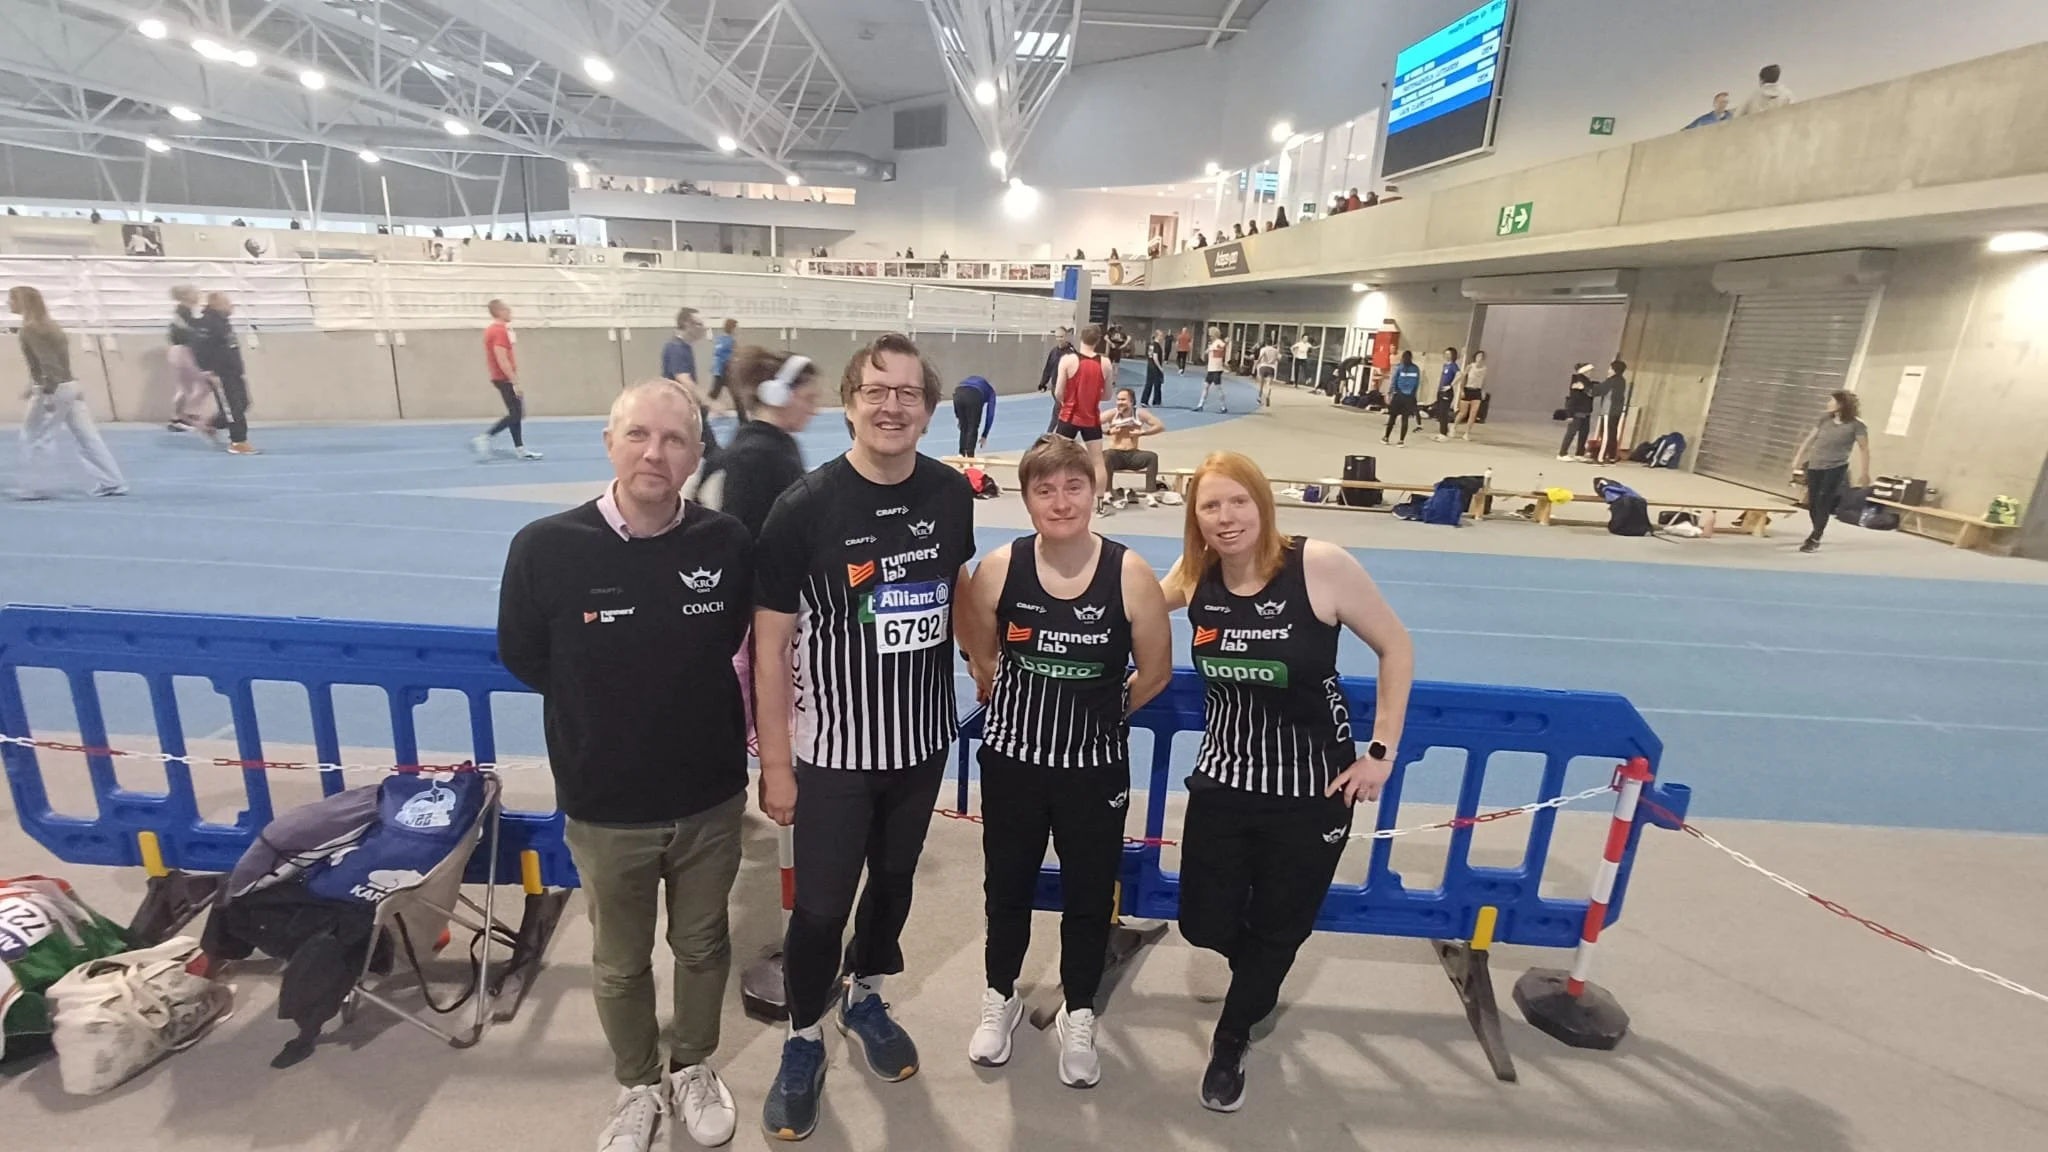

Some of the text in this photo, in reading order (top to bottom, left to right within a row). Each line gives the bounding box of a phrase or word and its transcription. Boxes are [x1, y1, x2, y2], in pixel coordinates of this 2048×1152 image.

[875, 507, 903, 517] CRAFT
[845, 536, 871, 546] CRAFT
[880, 543, 940, 569] runners'
[883, 566, 907, 583] lab
[880, 588, 935, 609] Allianz
[682, 601, 724, 615] COACH
[884, 614, 941, 646] 6792
[1038, 628, 1111, 643] runners'
[1223, 624, 1293, 640] runners'
[1037, 640, 1067, 654] lab
[1220, 639, 1248, 652] lab
[1020, 656, 1091, 679] bopro
[1201, 660, 1275, 682] bopro
